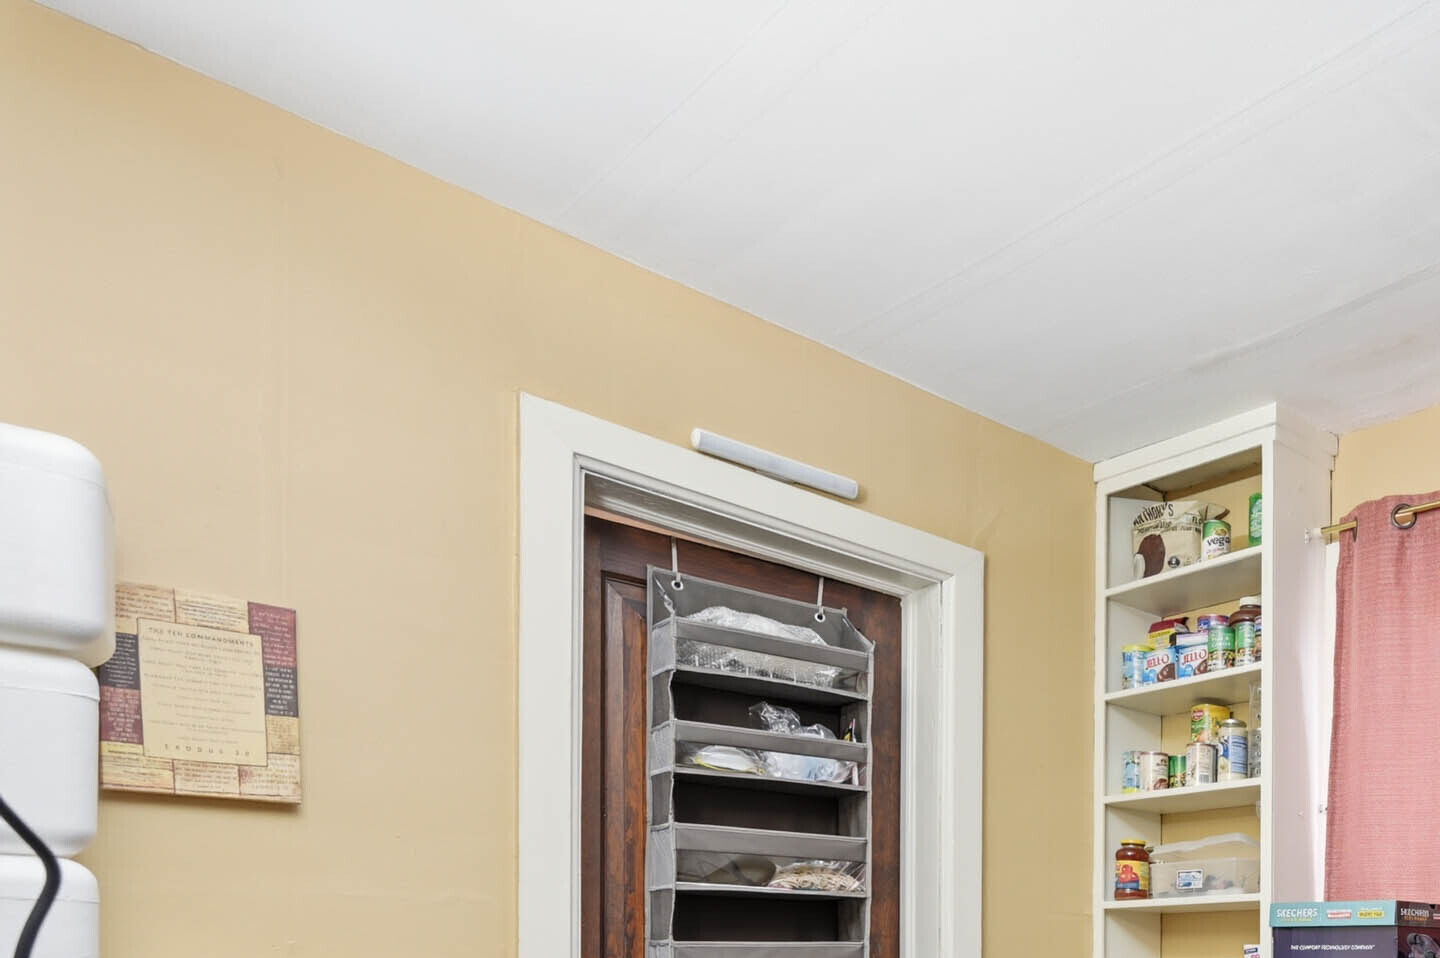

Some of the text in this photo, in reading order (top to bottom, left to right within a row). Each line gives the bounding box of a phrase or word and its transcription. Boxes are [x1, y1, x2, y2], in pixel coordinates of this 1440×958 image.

[185, 632, 254, 647] COMMANDMENTS
[165, 743, 224, 755] EXODUS
[1276, 908, 1318, 919] SKECHERS
